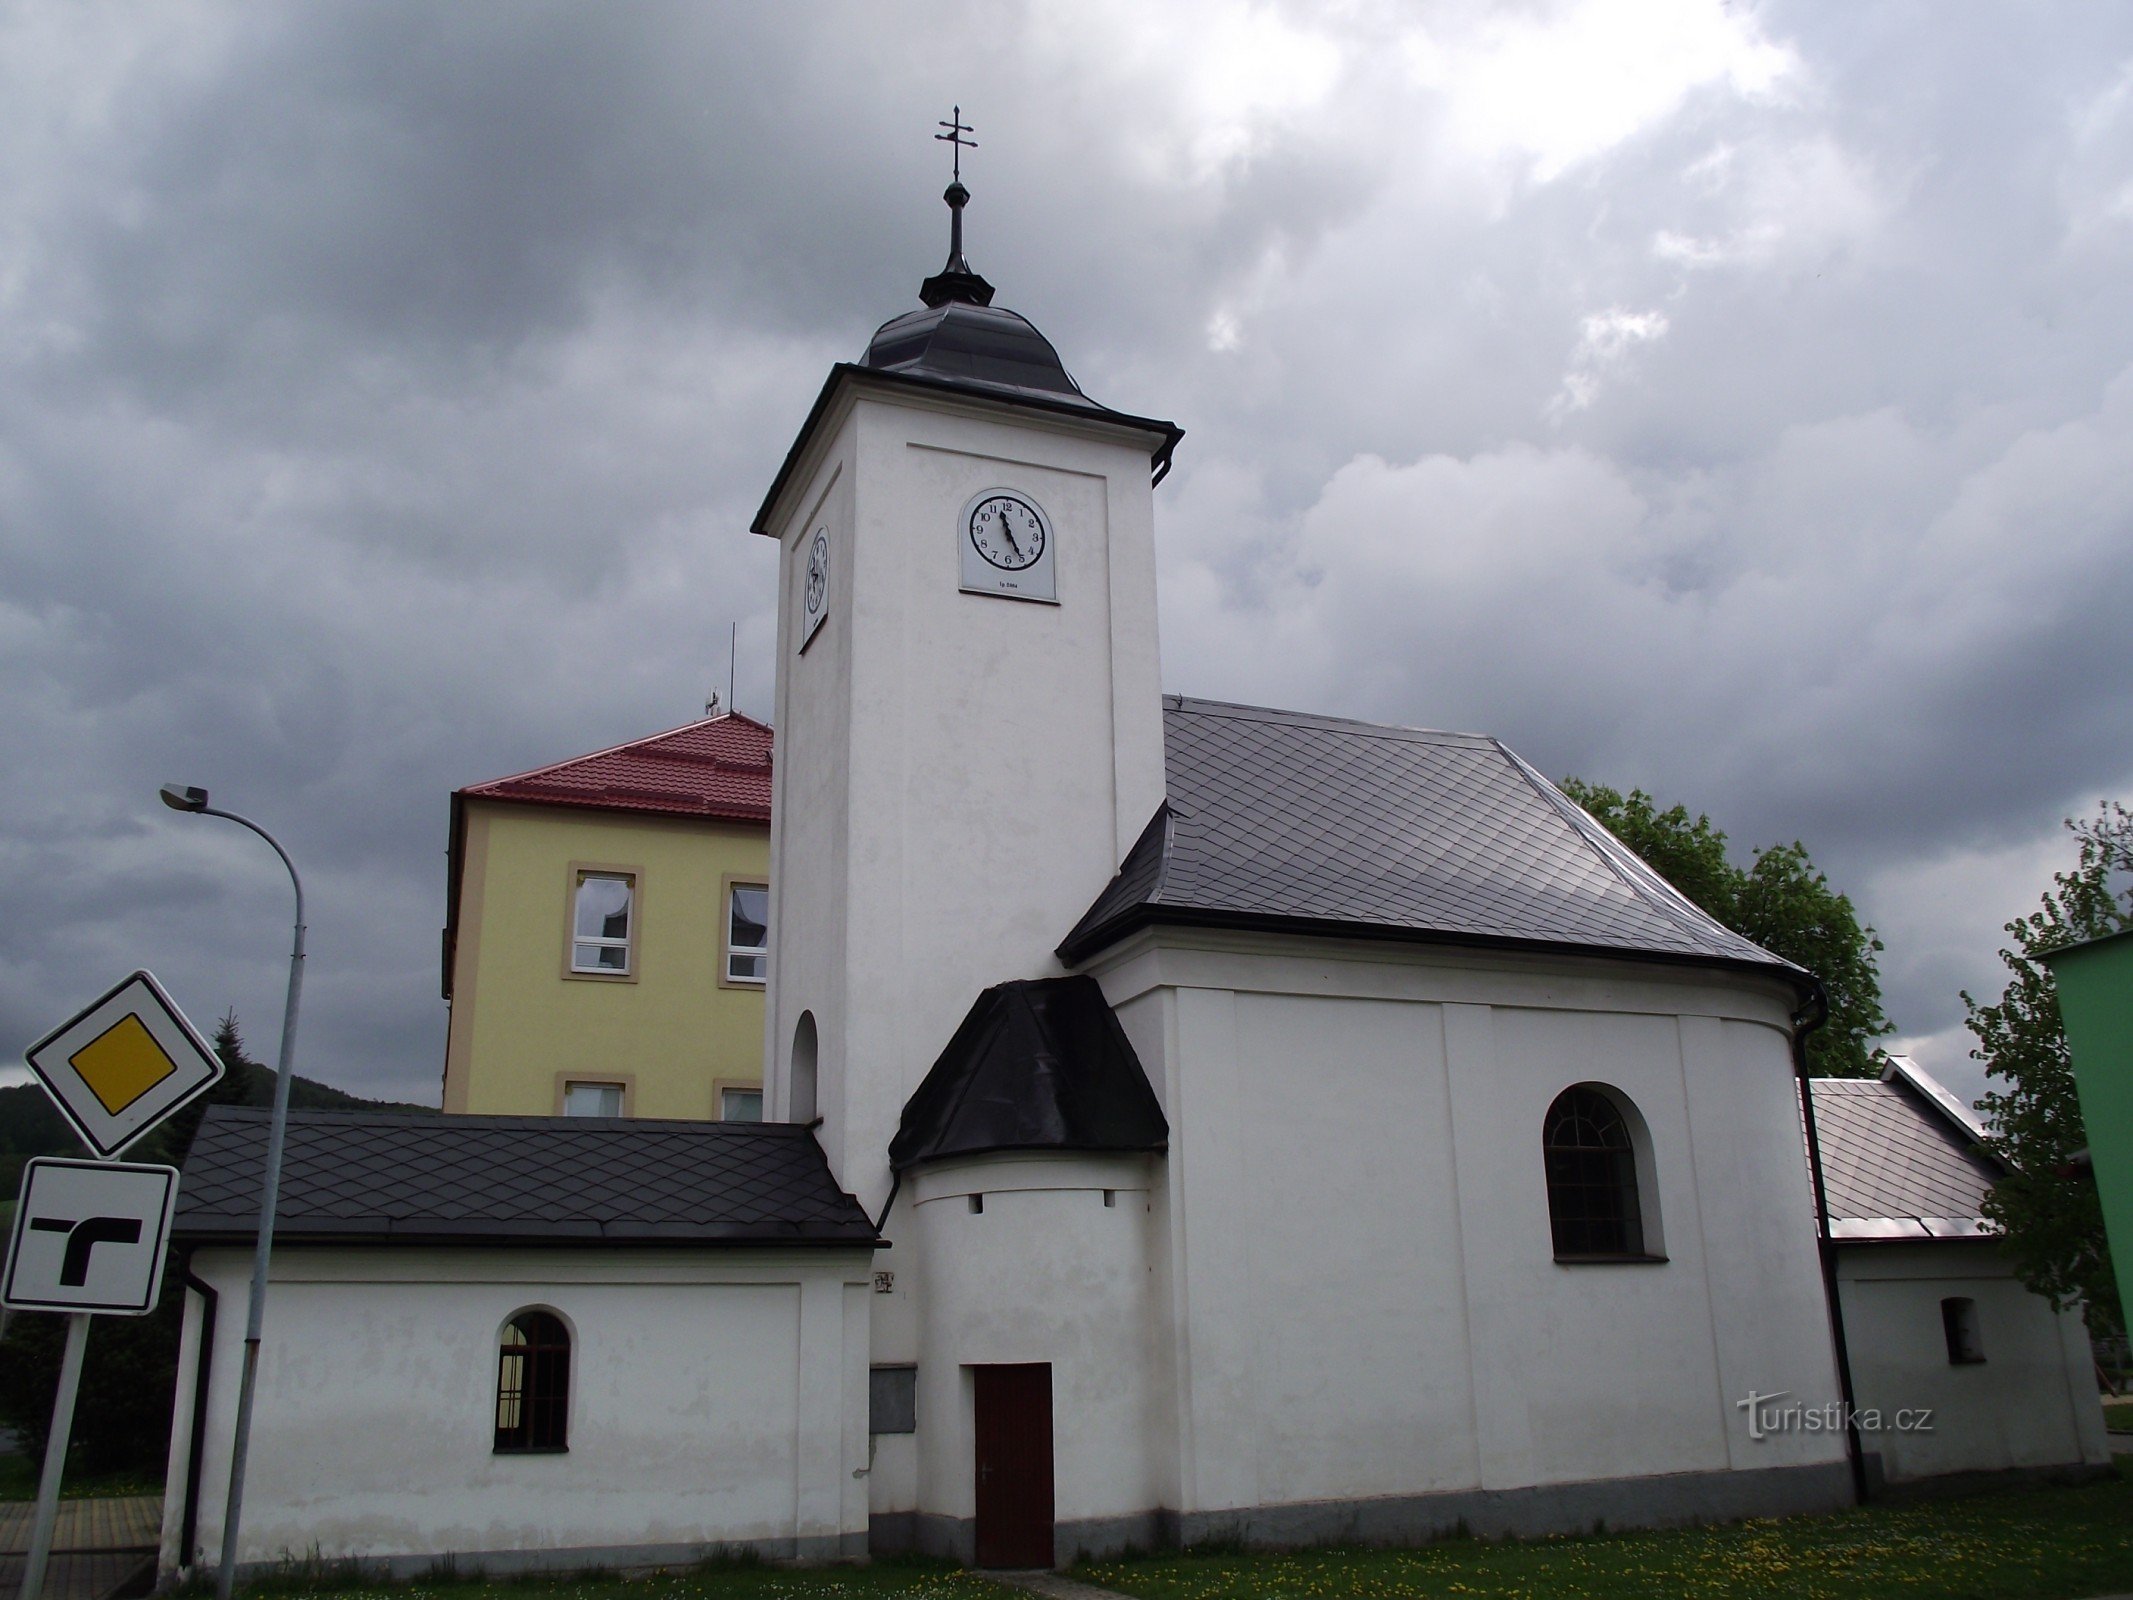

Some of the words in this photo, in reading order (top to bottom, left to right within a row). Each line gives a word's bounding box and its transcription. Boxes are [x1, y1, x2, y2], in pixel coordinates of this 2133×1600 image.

[989, 504, 997, 514] 11
[1002, 502, 1013, 512] 12
[1019, 508, 1024, 517] 1
[980, 513, 991, 522] 10
[1028, 518, 1035, 528] 2
[976, 525, 984, 534] 9
[1032, 532, 1039, 542] 3
[980, 539, 988, 548] 8
[992, 550, 998, 559] 7
[1028, 546, 1034, 555] 4
[1004, 555, 1012, 565] 6
[1018, 554, 1025, 563] 5
